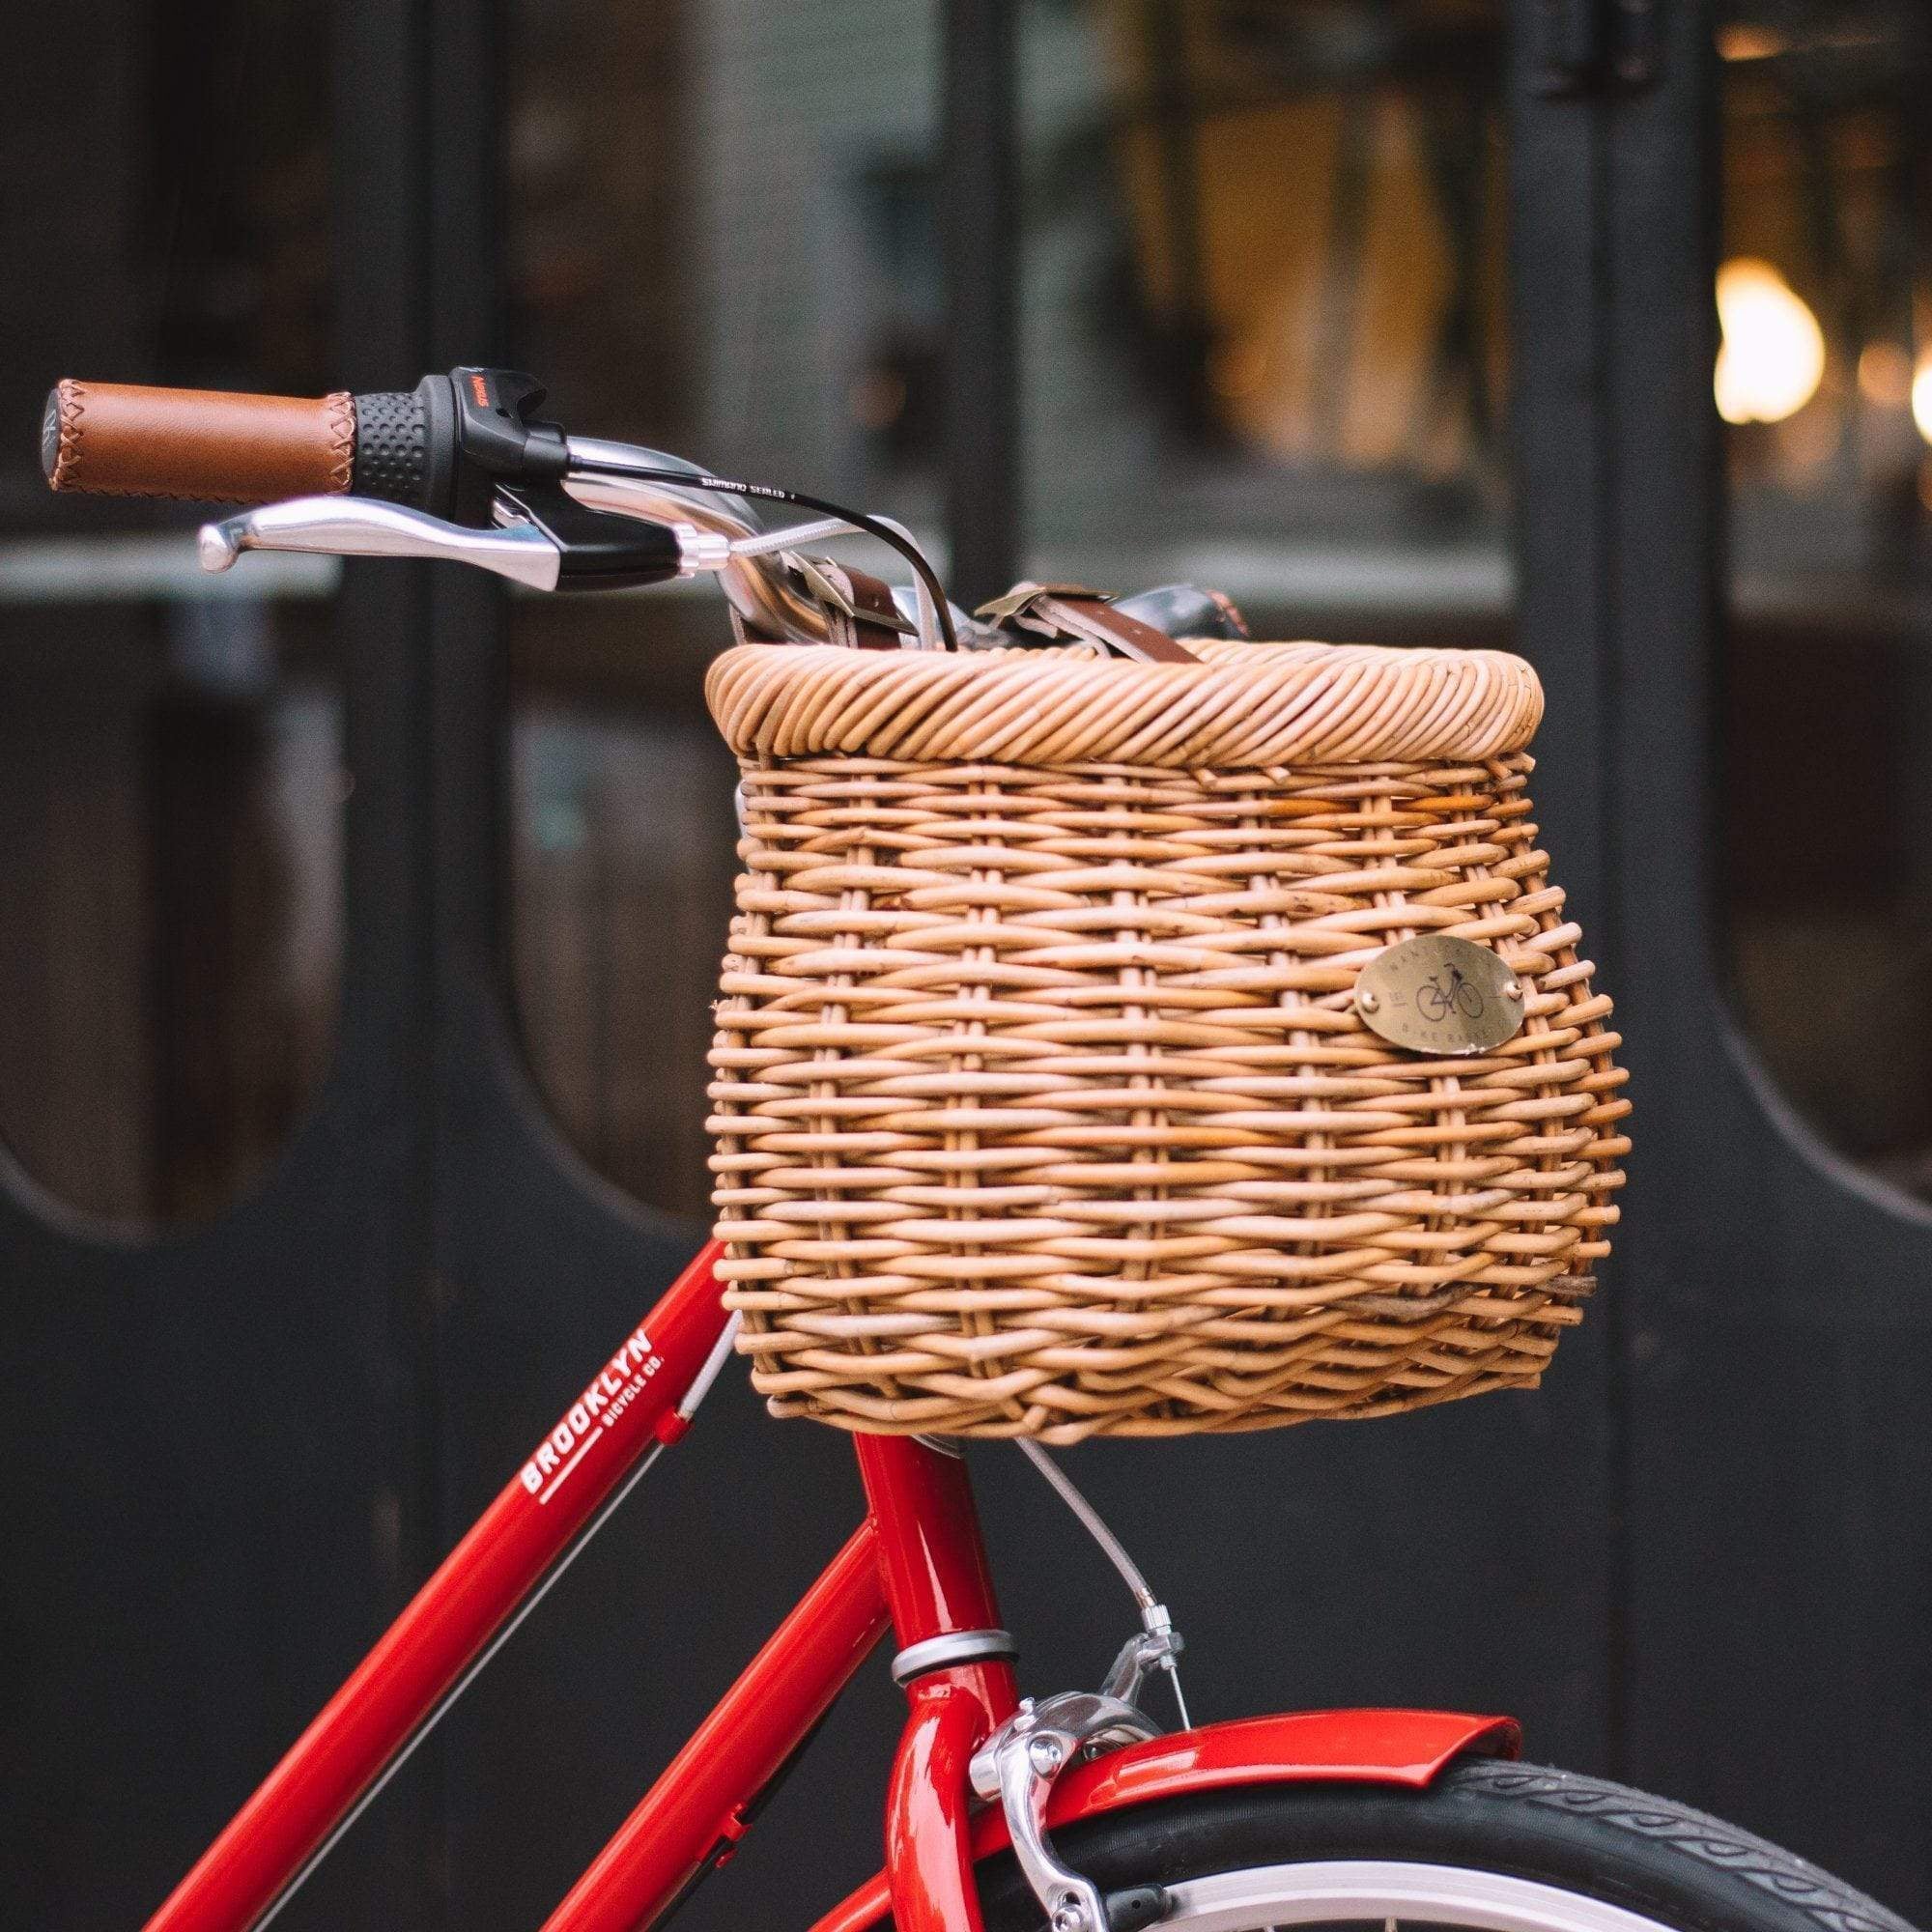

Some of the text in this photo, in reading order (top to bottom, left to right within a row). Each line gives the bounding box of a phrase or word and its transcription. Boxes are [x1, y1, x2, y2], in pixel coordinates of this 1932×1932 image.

[520, 1328, 653, 1494] BROOKLYN
[601, 1355, 665, 1428] BICYCLE CO.
